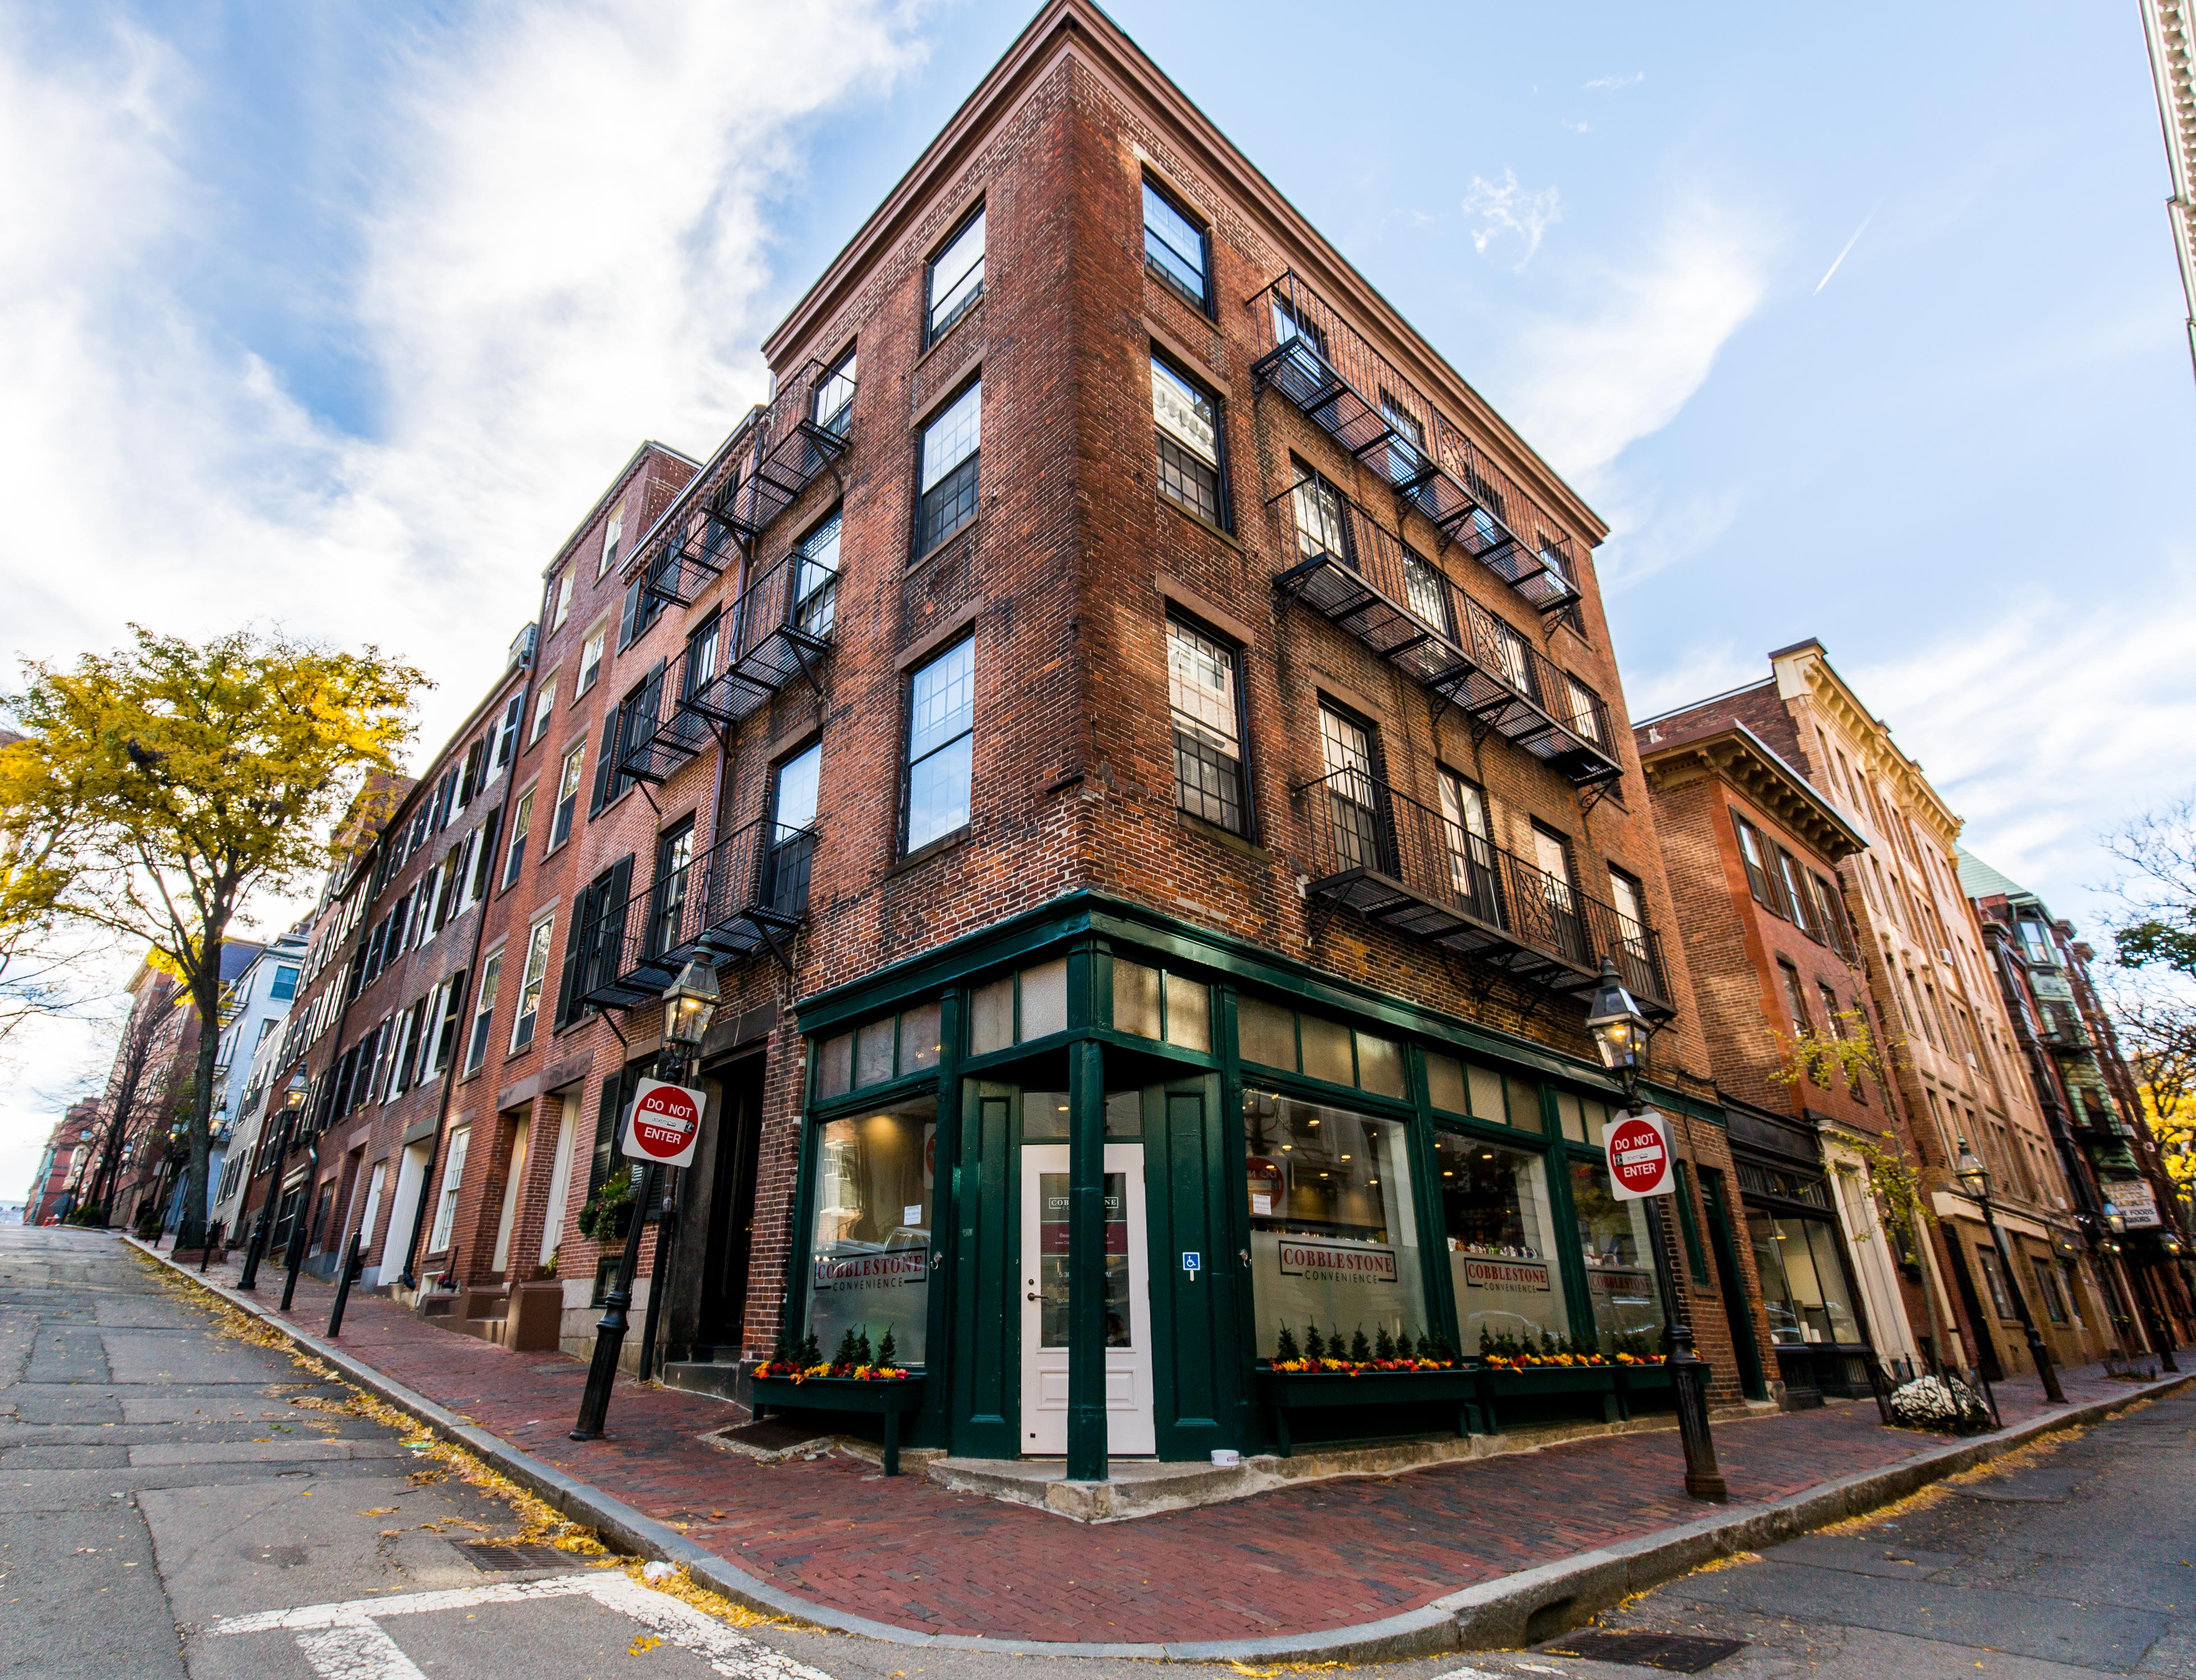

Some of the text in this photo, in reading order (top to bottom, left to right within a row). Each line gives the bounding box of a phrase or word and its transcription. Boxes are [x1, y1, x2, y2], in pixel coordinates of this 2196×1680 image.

[647, 1098, 693, 1118] DO NOT
[644, 1126, 681, 1145] ENTER
[1614, 1133, 1654, 1151] DO NOT
[1623, 1163, 1656, 1177] ENTER
[818, 1255, 922, 1280] COBBLESTONE
[1284, 1248, 1392, 1272] COBBLESTONE
[1305, 1270, 1377, 1284] CONVENIENCE
[1468, 1264, 1546, 1283] COBBLESTONE
[1591, 1275, 1650, 1290] COBBLESTONE
[833, 1277, 902, 1292] CONVENIENCE
[1484, 1282, 1535, 1293] CONVENIENCE
